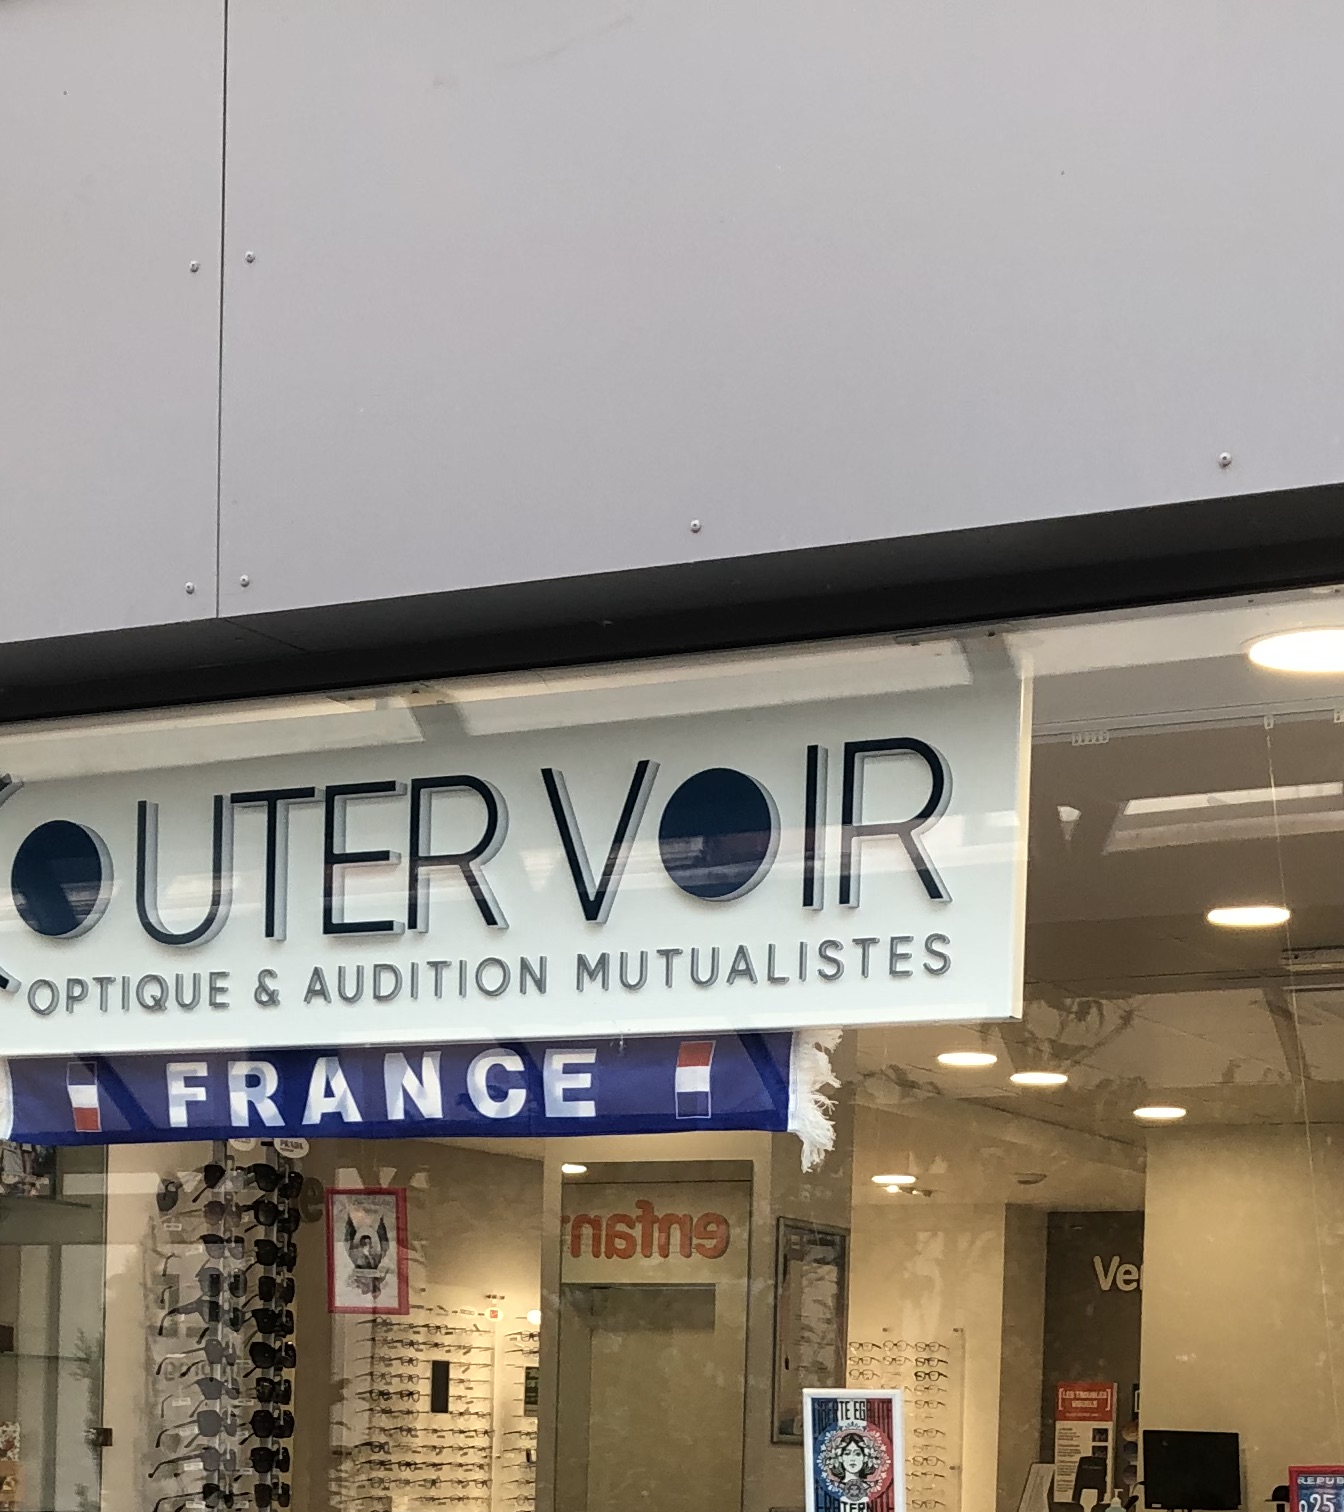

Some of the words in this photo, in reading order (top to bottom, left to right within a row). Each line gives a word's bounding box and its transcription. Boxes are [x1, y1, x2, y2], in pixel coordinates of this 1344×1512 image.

[541, 736, 954, 925] VOIR
[27, 969, 231, 1017] OPTIQUE
[253, 967, 281, 1008] &
[303, 954, 548, 1006] AUDITION
[575, 932, 952, 993] MUTUALISTES
[165, 1046, 598, 1129] FRANCE
